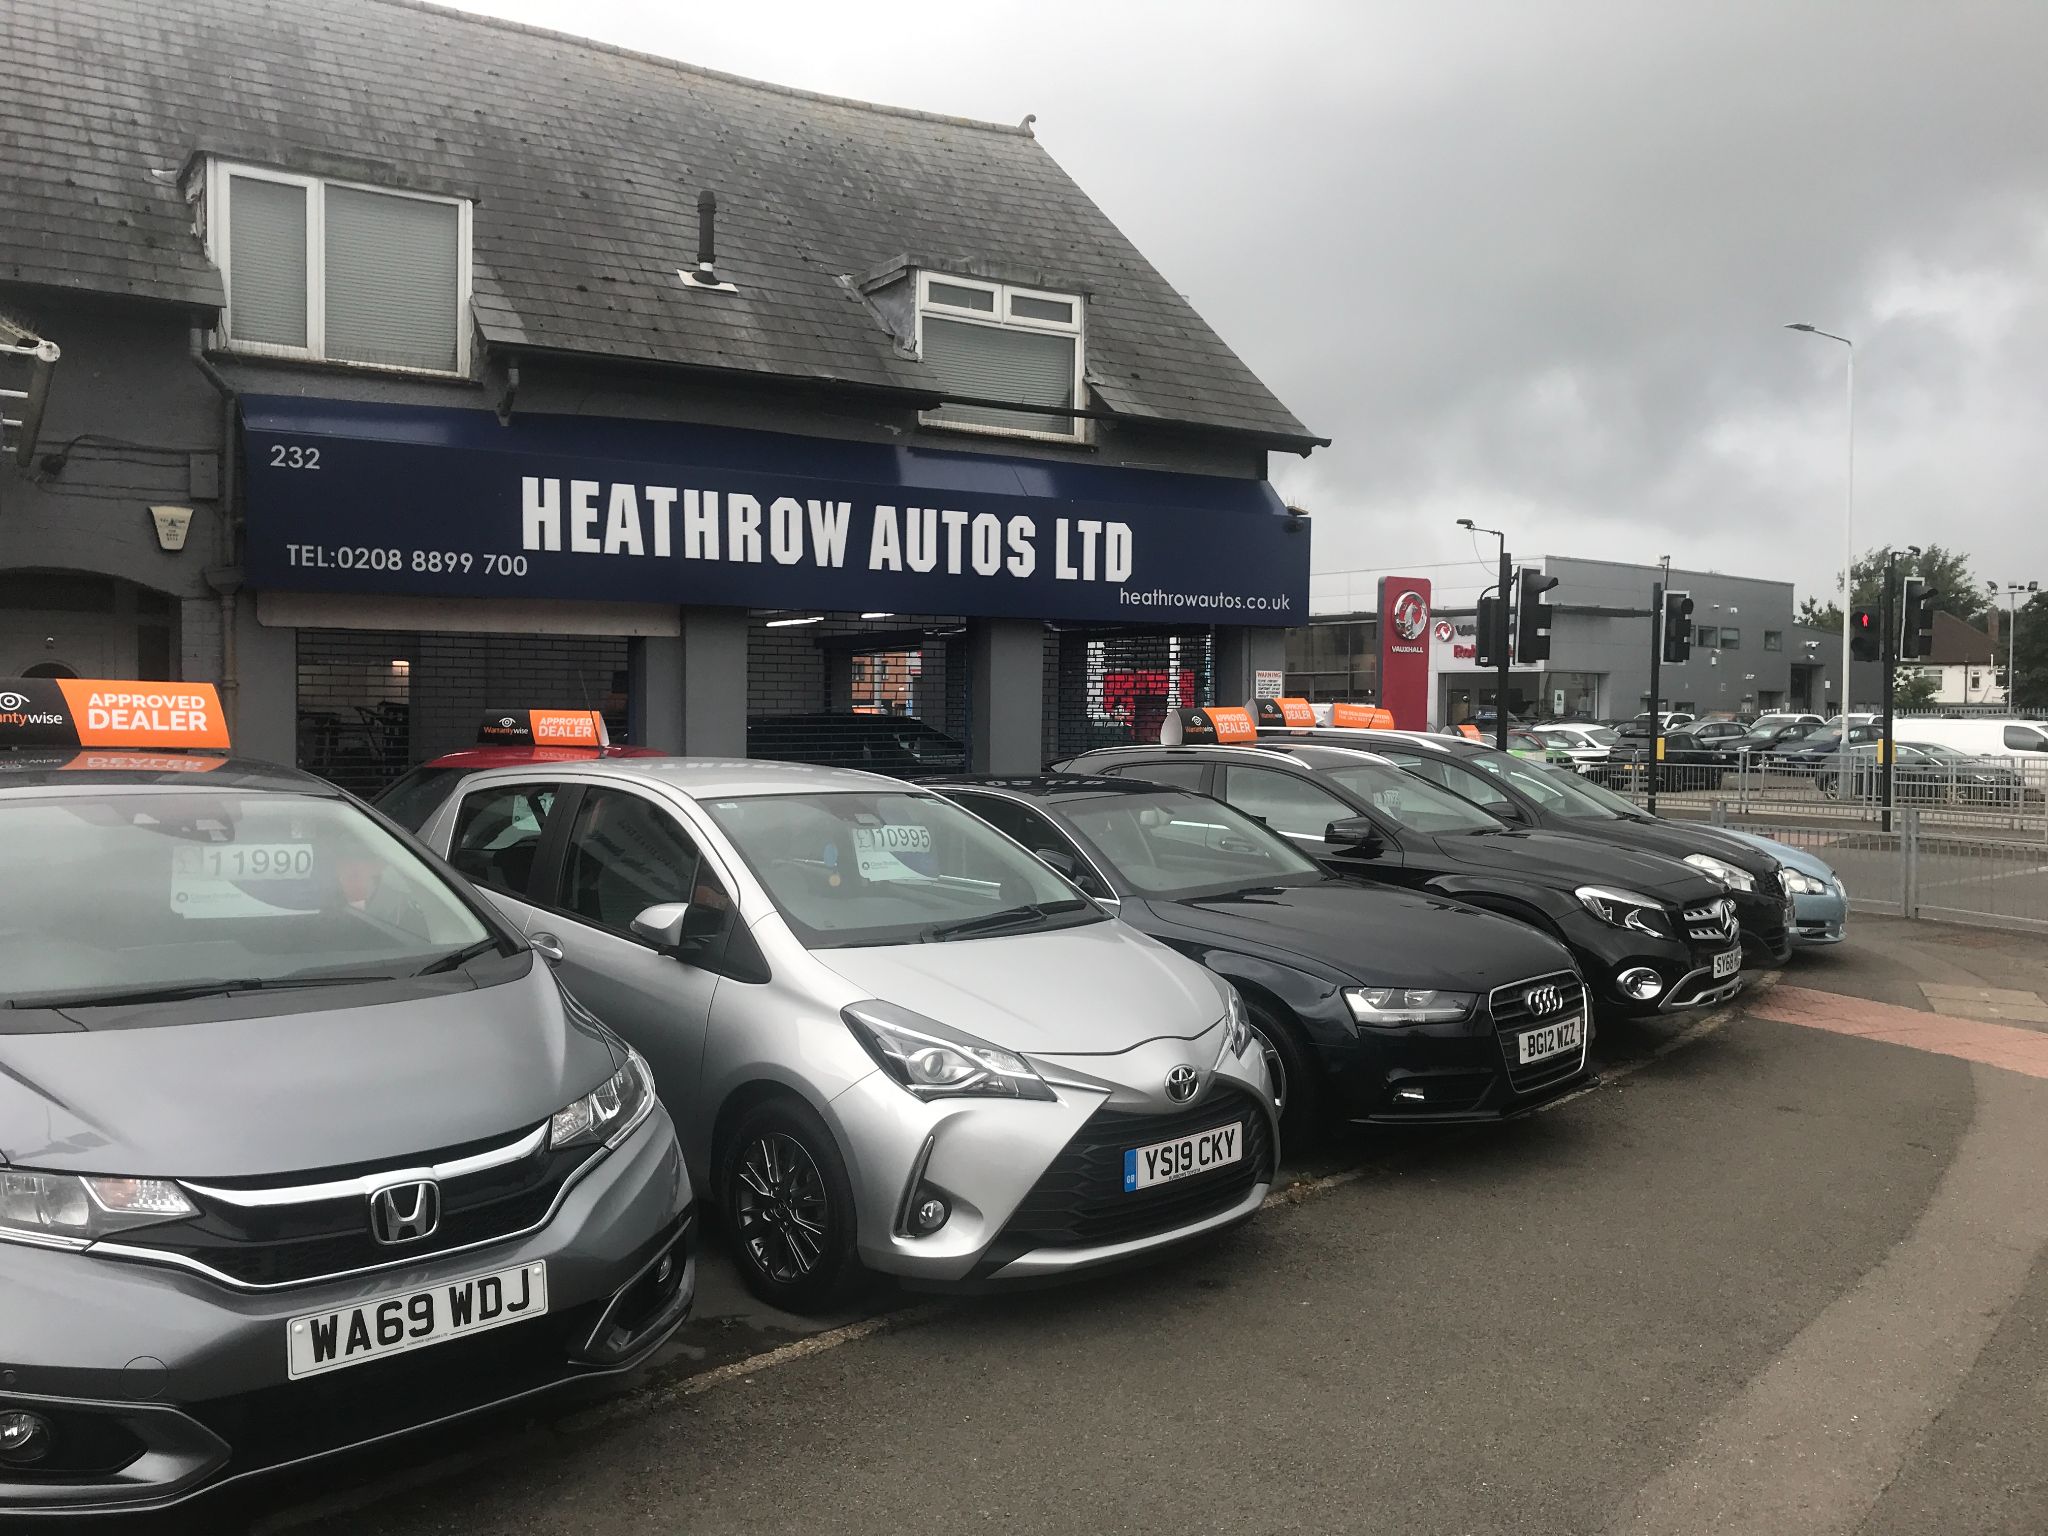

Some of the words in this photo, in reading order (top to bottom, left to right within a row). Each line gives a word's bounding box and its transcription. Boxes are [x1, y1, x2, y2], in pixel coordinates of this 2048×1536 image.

[270, 445, 320, 470] 232
[521, 476, 852, 568] HEATHROW
[868, 504, 1036, 578] AUTOS
[1055, 517, 1133, 583] LTD
[286, 544, 403, 571] TEL:0208
[411, 550, 473, 574] 8899
[483, 554, 528, 577] 700
[1120, 587, 1291, 611] heathrowautos.co.uk
[88, 693, 206, 709] APPROVED
[88, 708, 208, 732] DEALER
[539, 716, 593, 726] APPROVED
[1215, 713, 1248, 722] APPROVED
[1285, 710, 1312, 720] DEALER
[483, 726, 529, 736] Warrantywise
[538, 726, 592, 738] DEALER
[1218, 721, 1252, 734] DEALER
[1527, 1029, 1554, 1058] BG12
[1145, 1140, 1193, 1180] YS19
[1198, 1128, 1235, 1166] CKY
[1126, 1174, 1135, 1184] GB
[309, 1292, 435, 1363] WA69
[448, 1268, 531, 1328] WDJ
